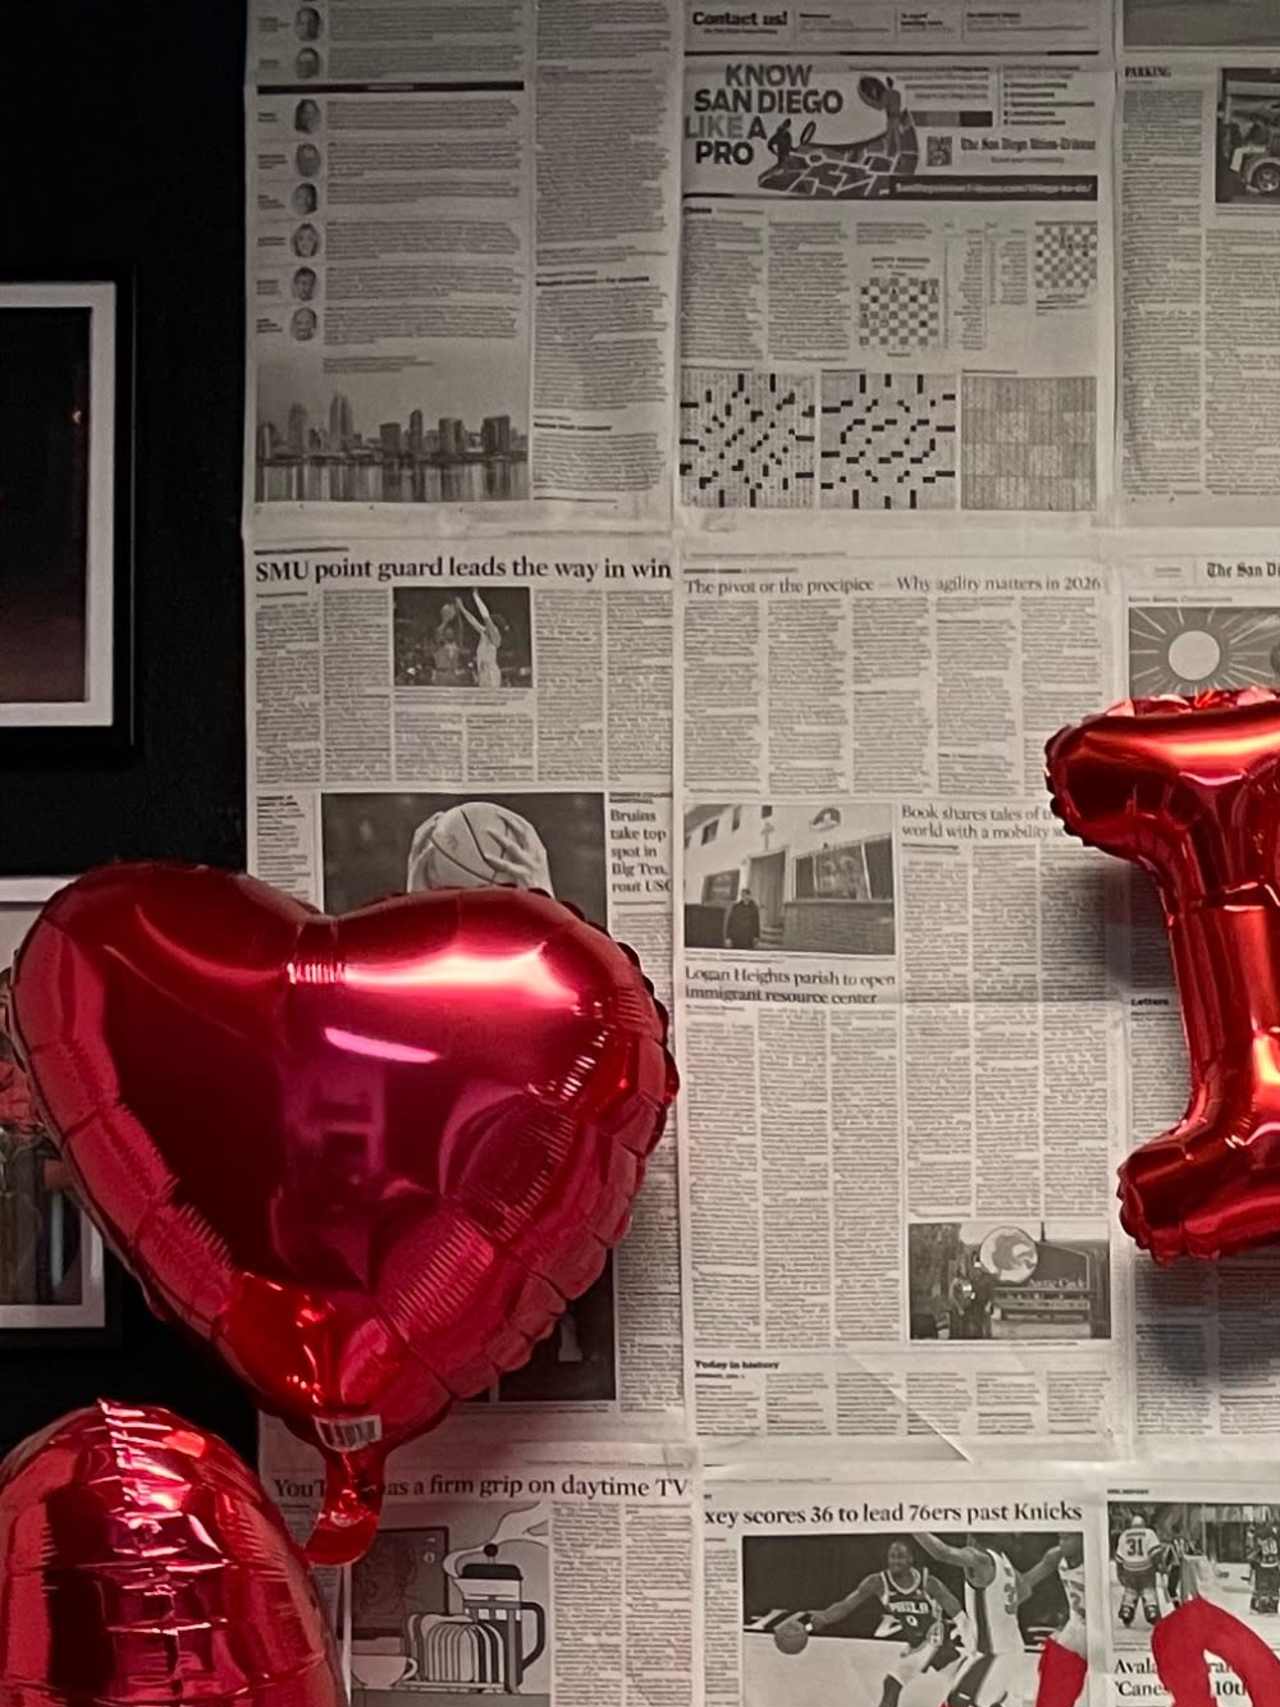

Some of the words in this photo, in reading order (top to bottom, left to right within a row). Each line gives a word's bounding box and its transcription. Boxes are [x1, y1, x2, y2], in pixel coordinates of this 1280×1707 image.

[692, 11, 758, 26] Contact
[763, 10, 788, 26] us!
[723, 64, 813, 88] KNOW
[694, 88, 752, 114] SAN
[758, 89, 844, 115] DIEGO
[684, 116, 744, 140] LIKE
[746, 116, 768, 140] A
[696, 141, 754, 166] PRO
[256, 561, 308, 582] SMU
[315, 558, 372, 584] point
[378, 557, 443, 582] guard
[449, 557, 506, 576] leads
[512, 557, 548, 577] the
[555, 563, 598, 583] way
[605, 558, 625, 578] in
[632, 558, 672, 580] win
[743, 1511, 806, 1524] scores
[810, 1506, 833, 1523] 36
[838, 1508, 858, 1522] to
[864, 1504, 904, 1522] lead
[909, 1505, 961, 1521] 76ers
[967, 1506, 1008, 1525] past
[1014, 1504, 1082, 1520] Knicks
[1126, 1537, 1144, 1557] 31
